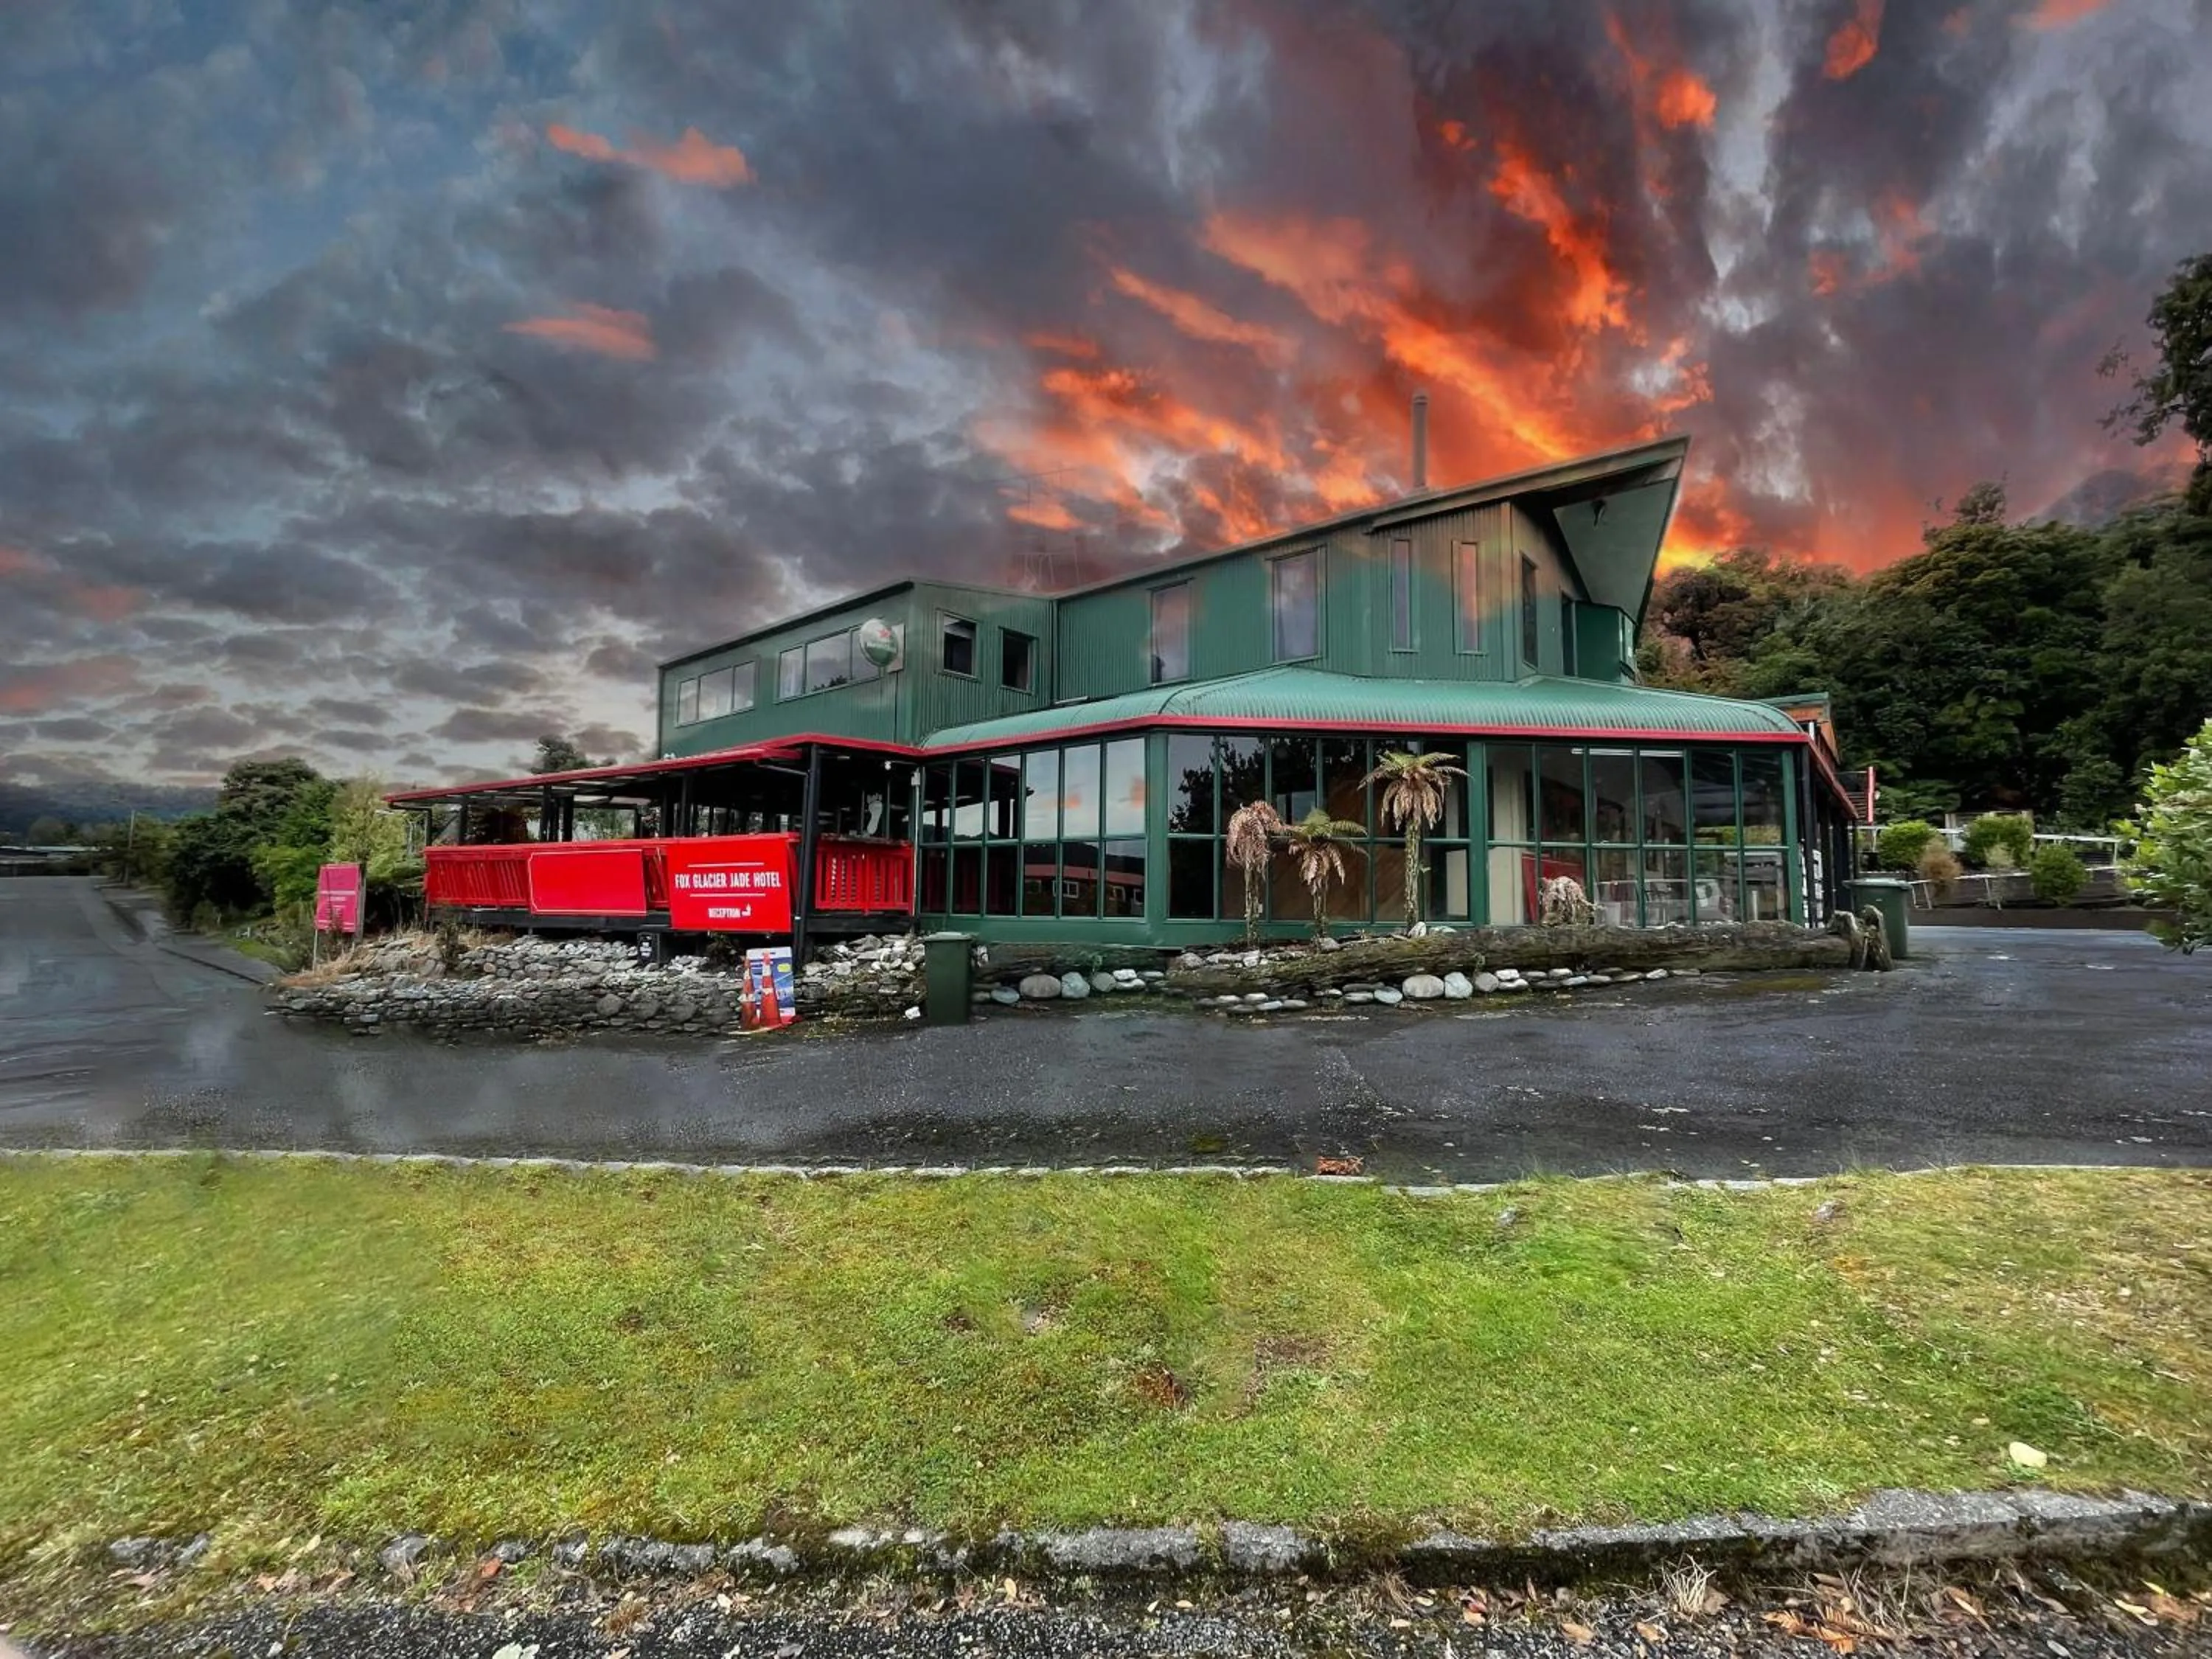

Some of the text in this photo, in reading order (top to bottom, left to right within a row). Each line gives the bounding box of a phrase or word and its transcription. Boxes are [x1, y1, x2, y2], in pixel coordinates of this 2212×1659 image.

[675, 872, 781, 888] FOX GLACIER JADE HOTEL
